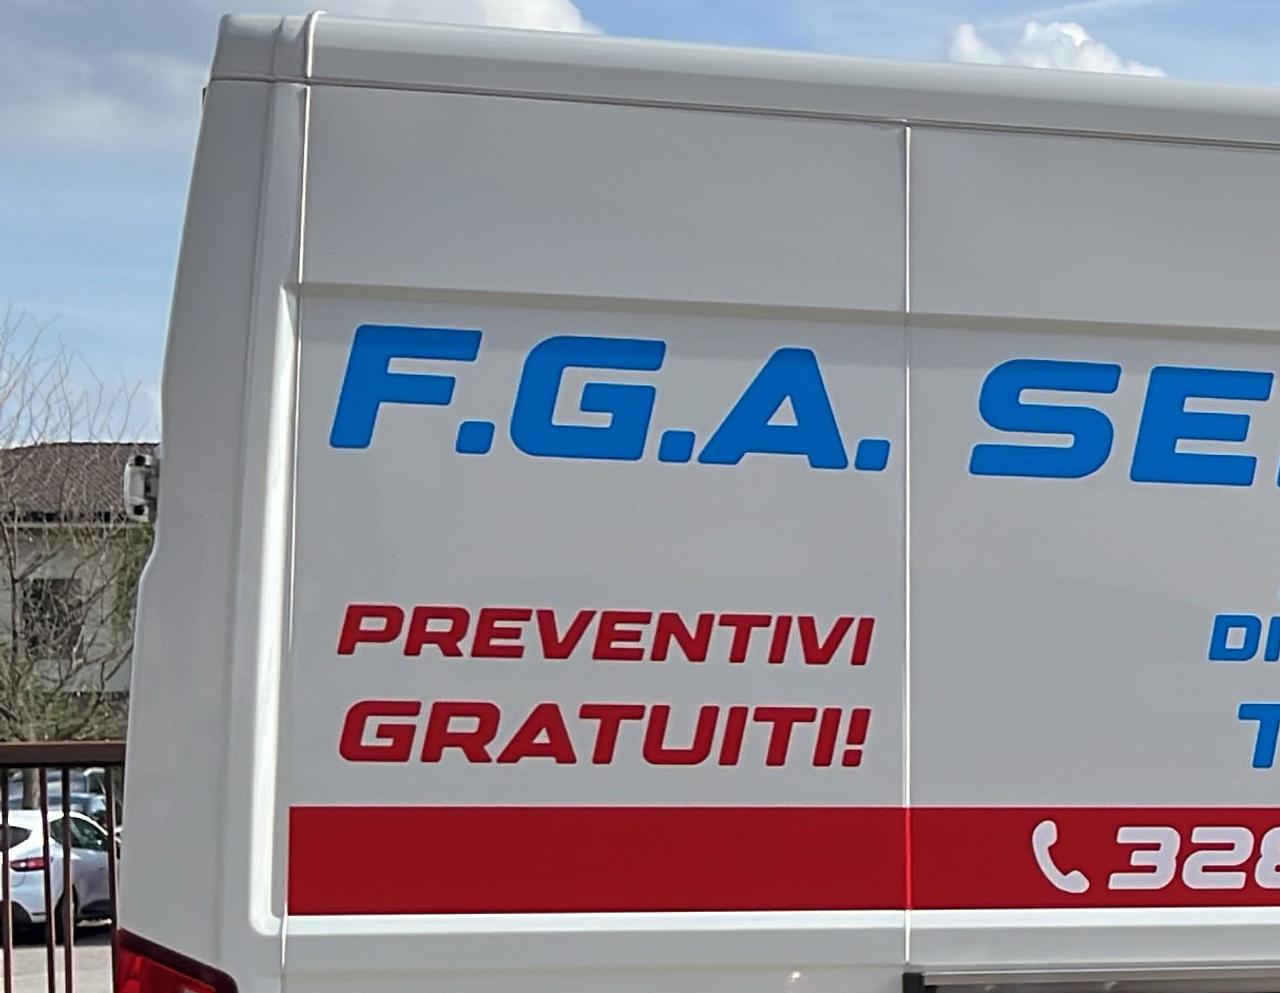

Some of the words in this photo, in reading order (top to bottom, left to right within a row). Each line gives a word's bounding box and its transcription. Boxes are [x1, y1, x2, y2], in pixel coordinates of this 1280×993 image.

[329, 324, 891, 472] F.G.A.
[336, 604, 876, 667] PREVENTIVI
[338, 699, 872, 768] GRATUITI!
